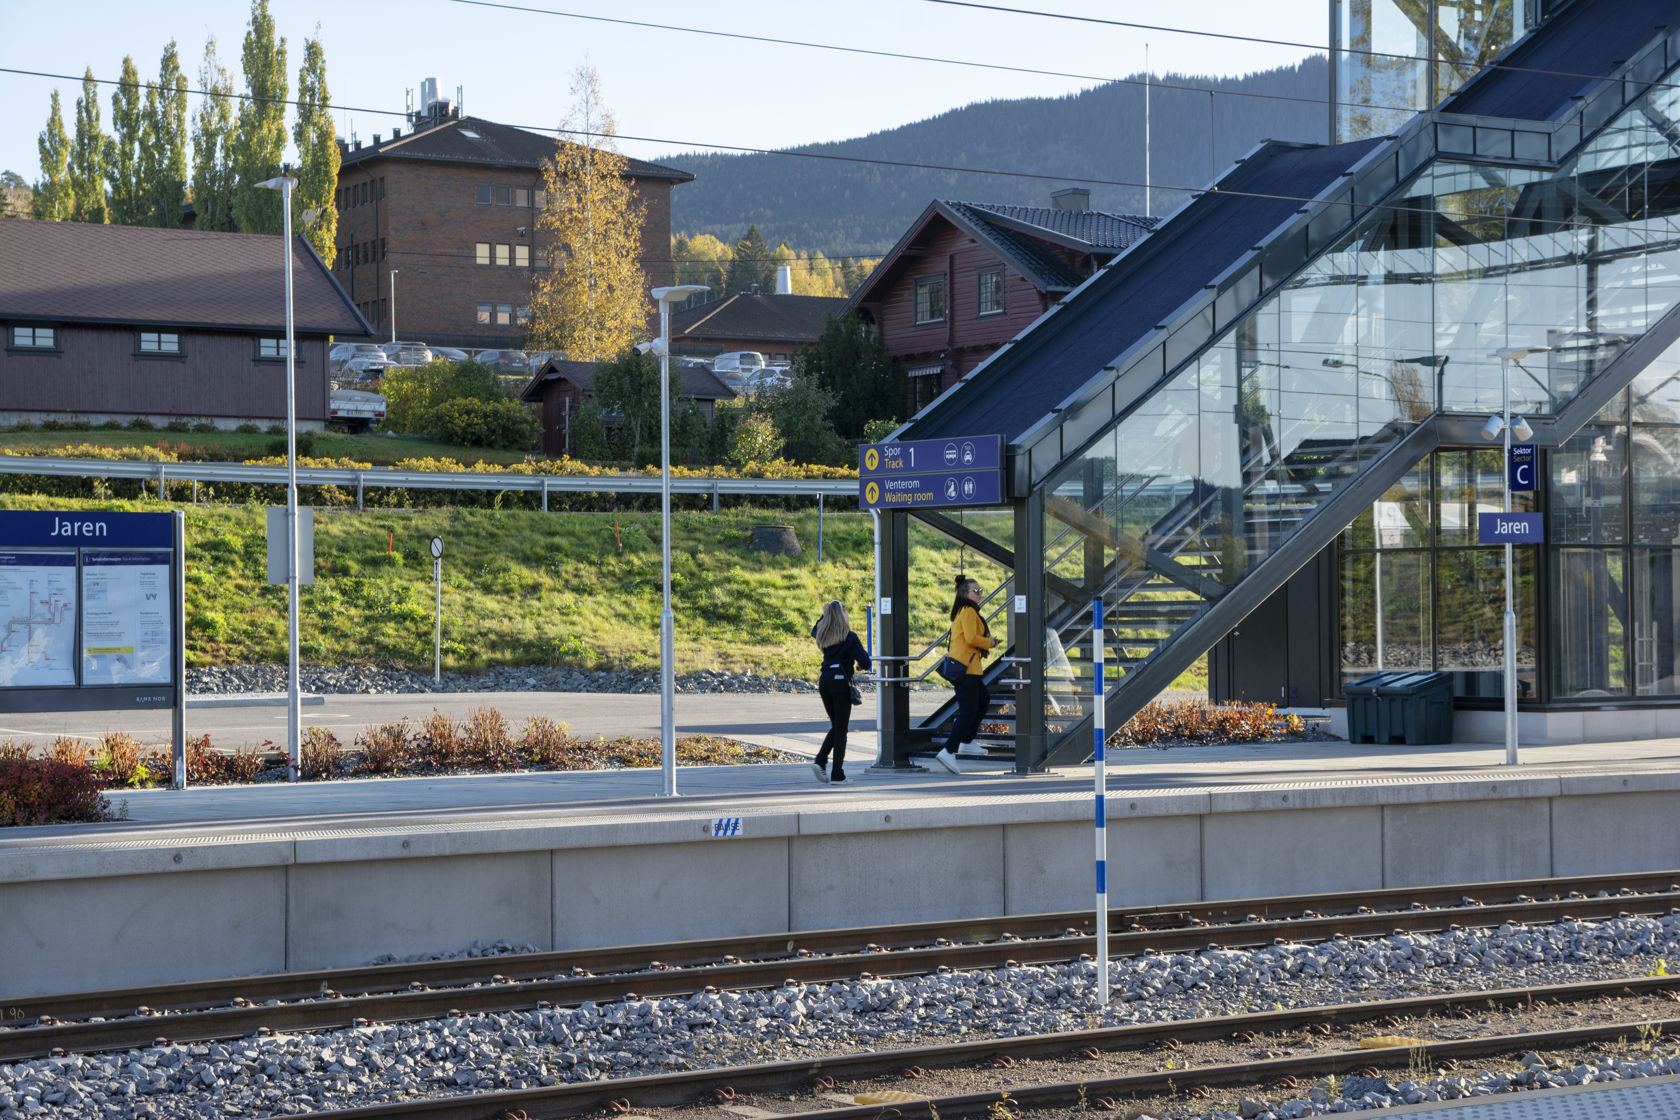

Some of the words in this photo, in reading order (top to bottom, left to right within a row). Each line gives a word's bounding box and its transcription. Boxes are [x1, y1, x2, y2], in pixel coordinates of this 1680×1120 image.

[884, 445, 901, 458] Spor
[909, 447, 915, 467] 1
[1513, 447, 1532, 455] Sektor
[884, 457, 904, 469] Track
[1513, 455, 1532, 463] Sector
[1516, 464, 1529, 485] C
[884, 479, 920, 490] Venterom
[884, 491, 913, 504] Waiting
[913, 491, 934, 502] room
[50, 516, 107, 536] Jaren
[1494, 518, 1529, 535] Jaren
